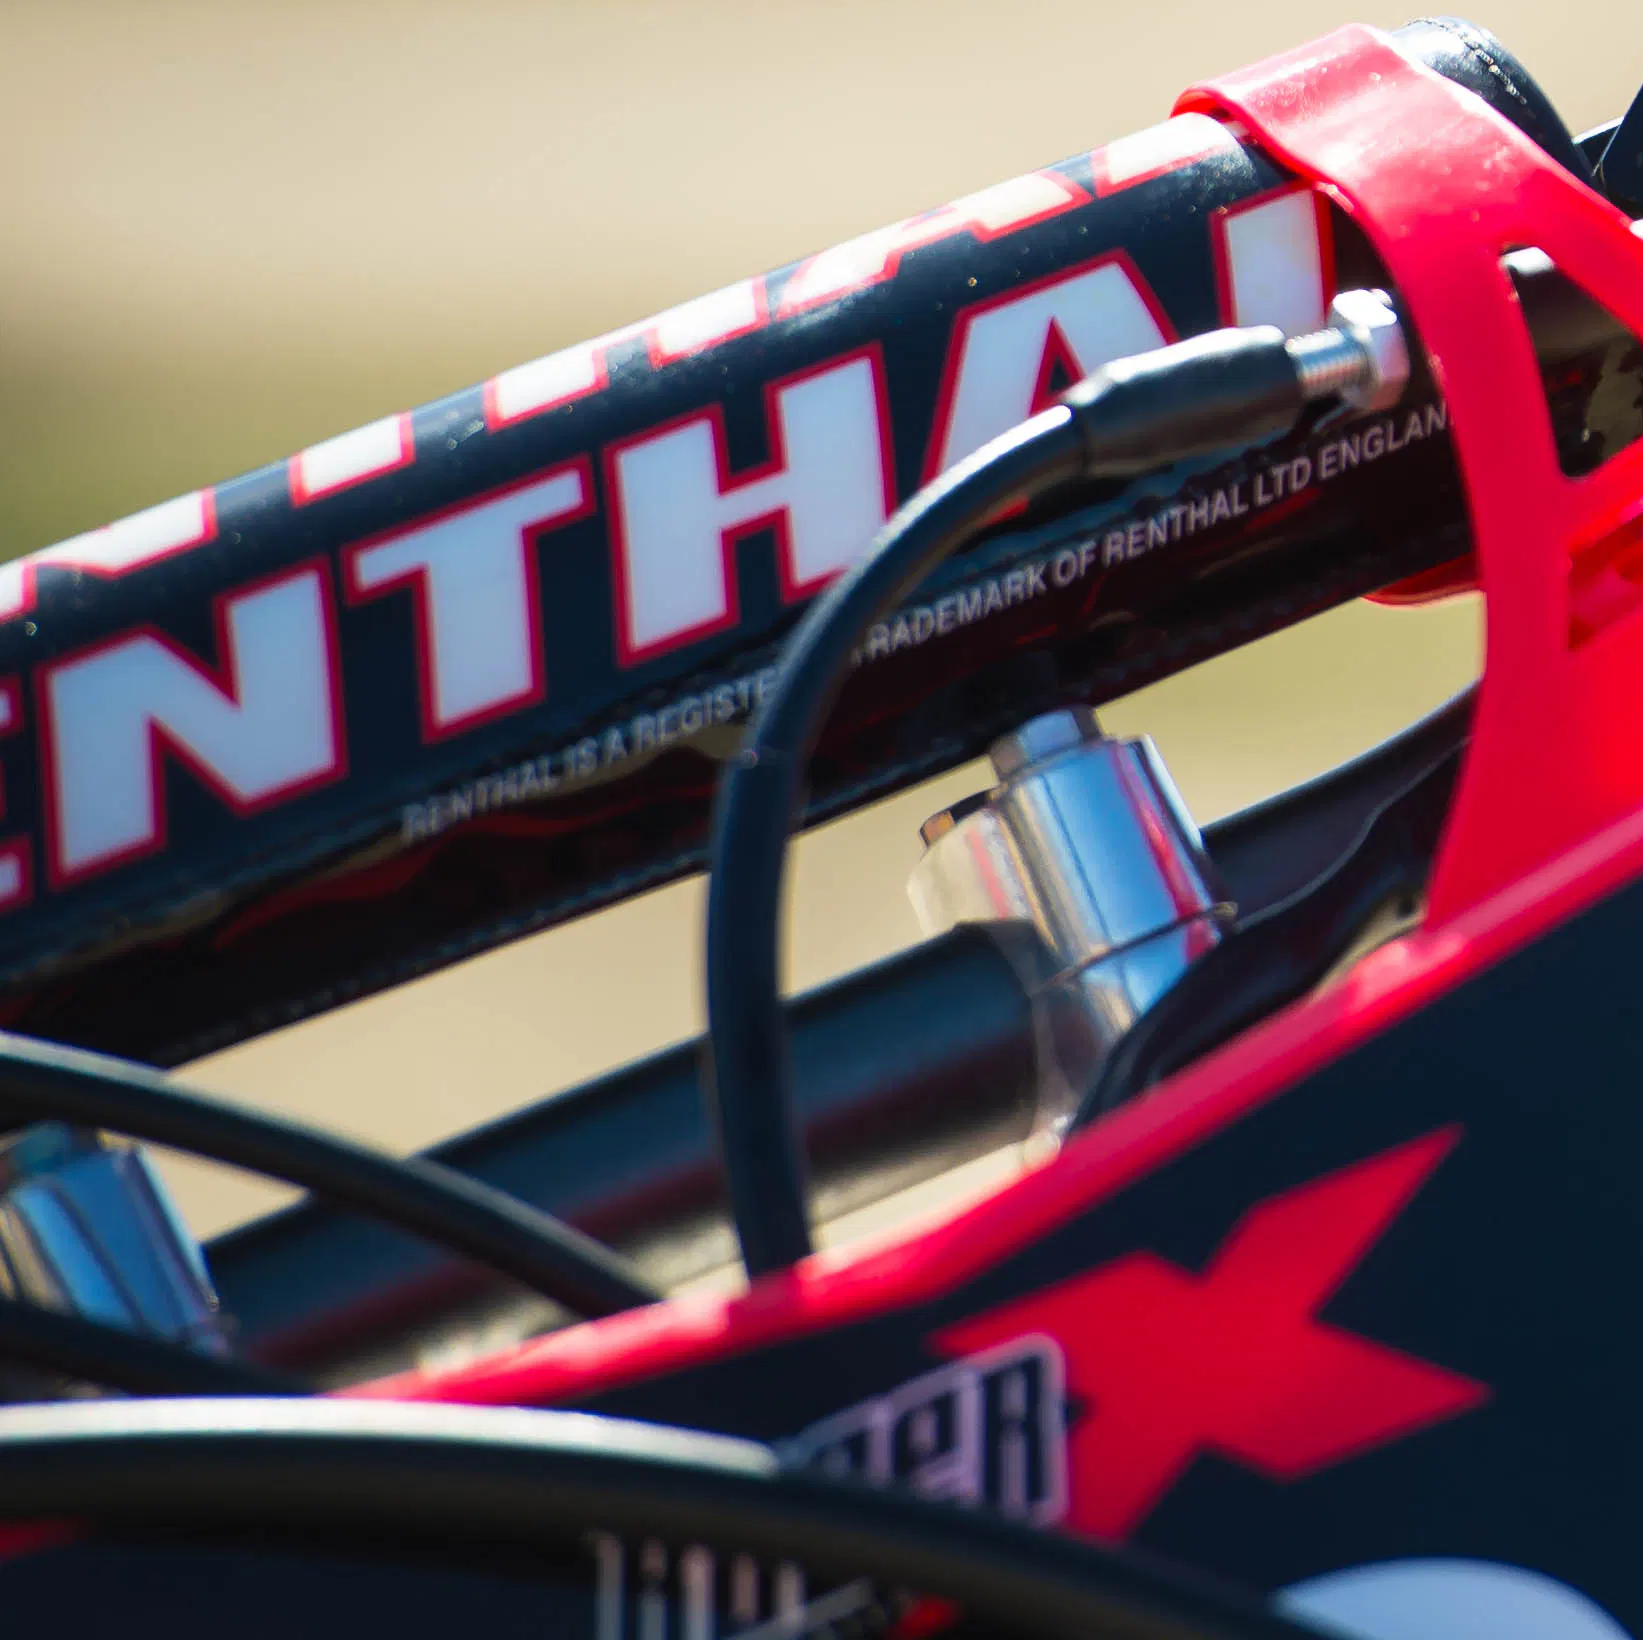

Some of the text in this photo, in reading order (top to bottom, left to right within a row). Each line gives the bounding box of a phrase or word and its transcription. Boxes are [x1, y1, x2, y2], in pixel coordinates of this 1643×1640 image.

[0, 182, 1338, 913] NTHA
[401, 755, 560, 846] RENTHAL
[563, 735, 600, 779] IS
[603, 726, 629, 764] A
[632, 663, 780, 755] REGISTE
[1052, 539, 1097, 589] OF
[1102, 482, 1250, 568] RENTHAL
[1252, 455, 1312, 508] LTD
[1318, 400, 1452, 482] ENGLAN
